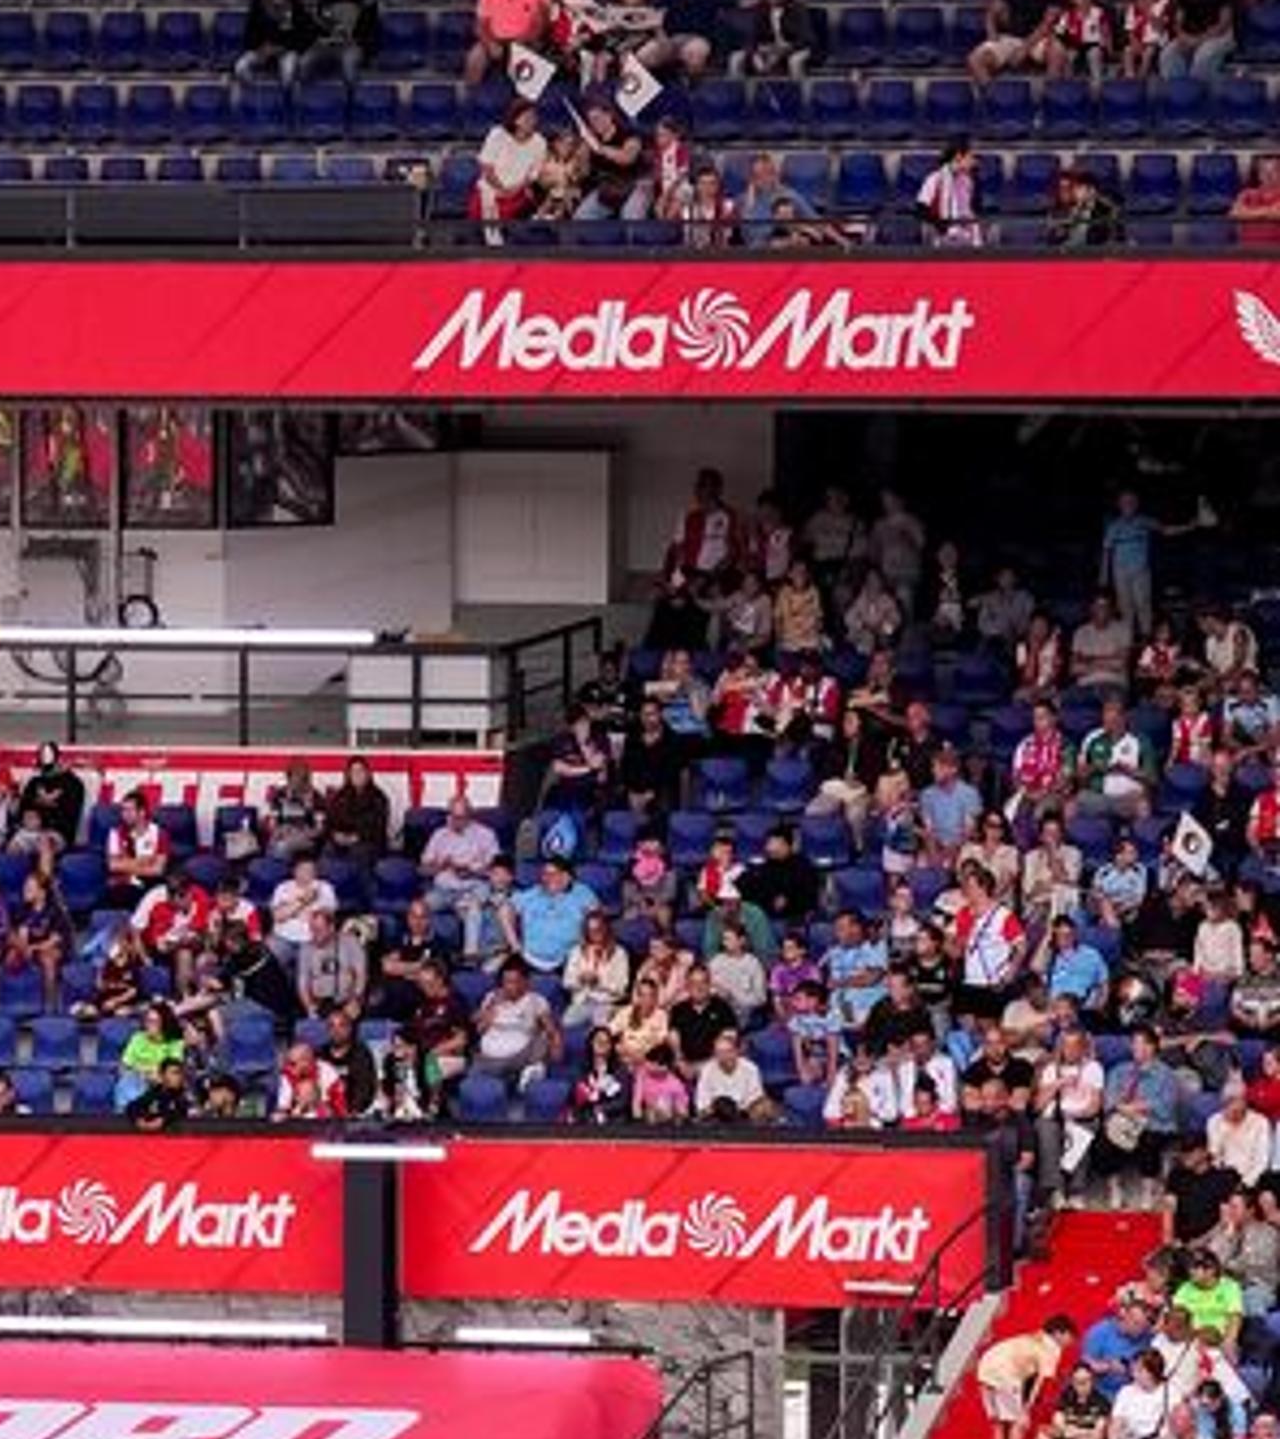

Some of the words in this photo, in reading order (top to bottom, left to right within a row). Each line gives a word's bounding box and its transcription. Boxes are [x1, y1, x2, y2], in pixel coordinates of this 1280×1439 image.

[413, 288, 670, 370] Media
[740, 290, 973, 373] Markt
[110, 1182, 296, 1248] Markt
[469, 1189, 680, 1257] Media
[740, 1194, 929, 1261] Markt
